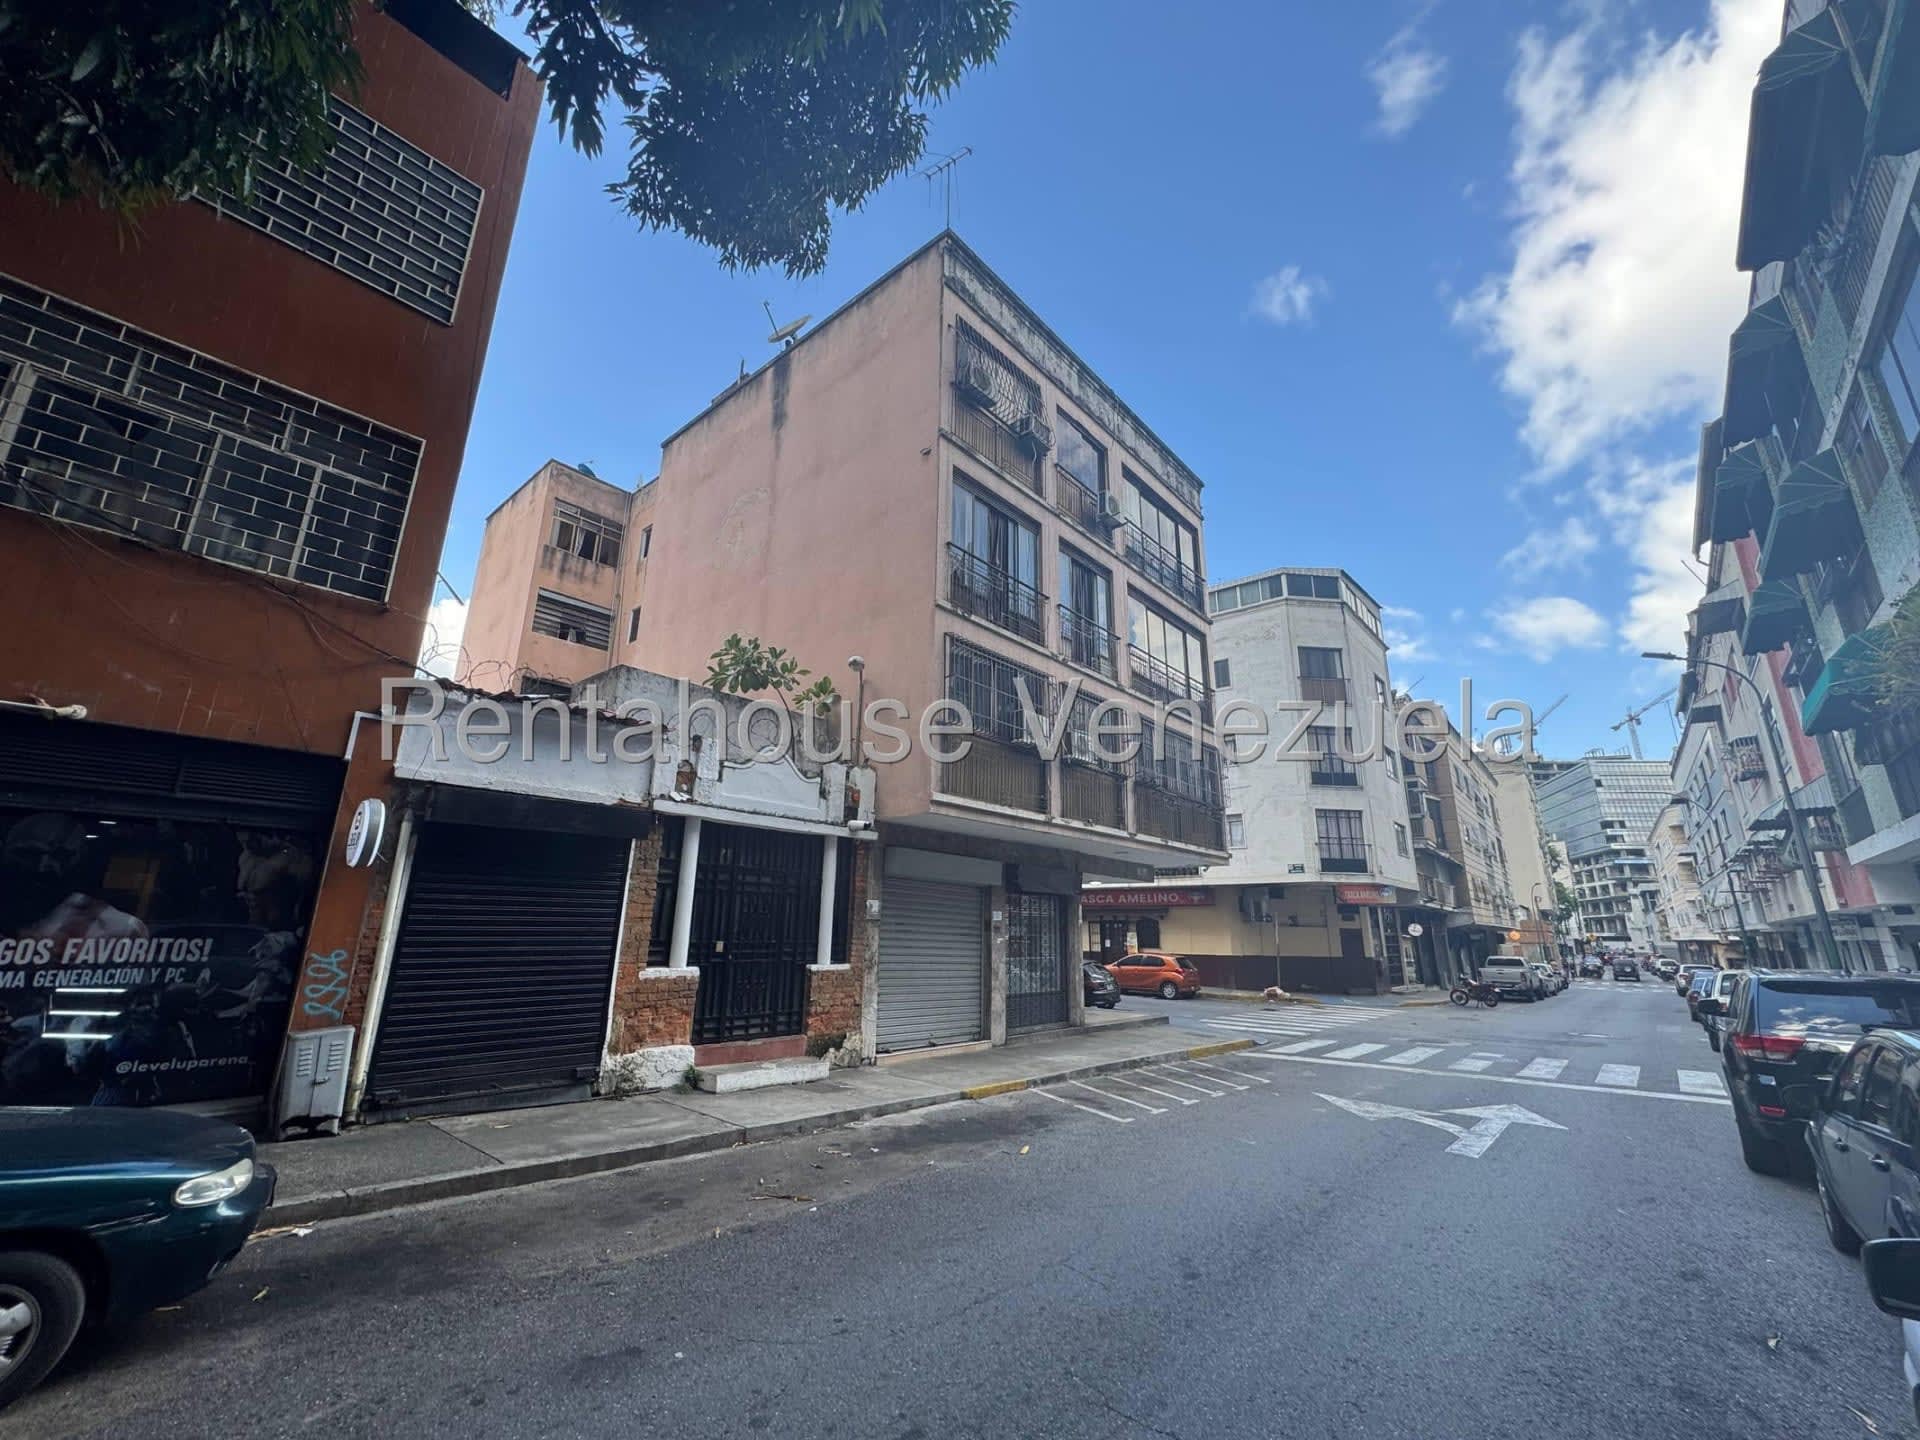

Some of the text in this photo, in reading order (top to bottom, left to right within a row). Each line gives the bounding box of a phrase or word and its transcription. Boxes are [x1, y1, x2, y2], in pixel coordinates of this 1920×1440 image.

[1118, 892, 1180, 904] AMELINO
[61, 937, 214, 965] FAVORITOS!
[150, 967, 162, 984] Y
[164, 967, 186, 984] PC
[115, 1055, 249, 1075] @leveluparena
